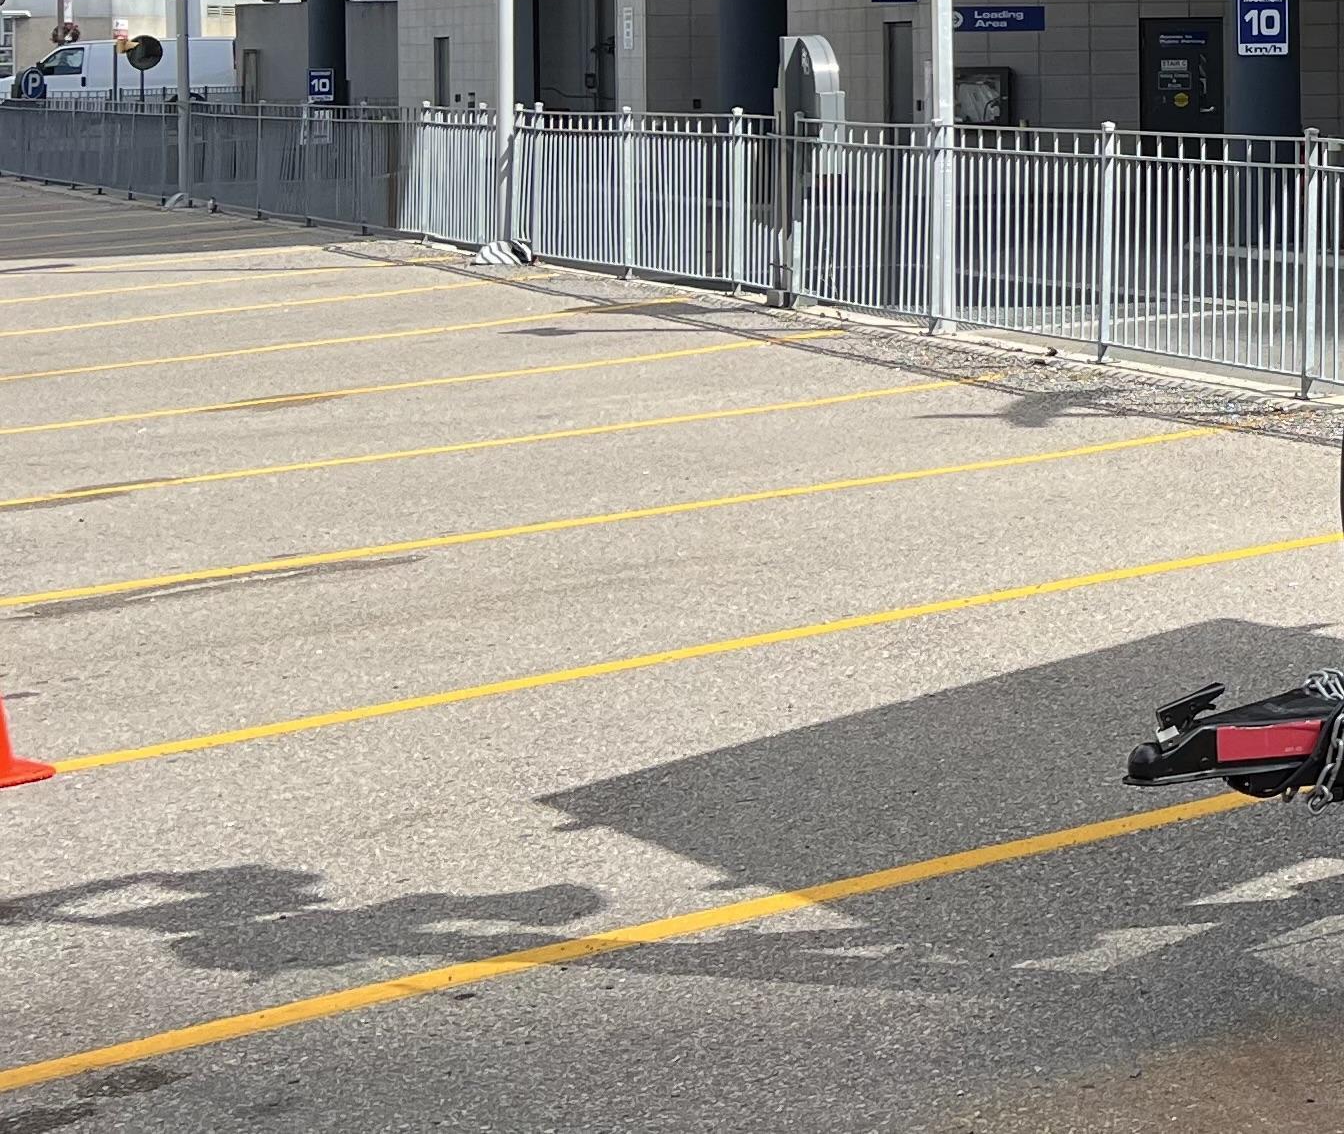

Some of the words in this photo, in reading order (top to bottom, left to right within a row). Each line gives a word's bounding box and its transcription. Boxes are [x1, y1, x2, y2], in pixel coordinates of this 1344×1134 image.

[974, 10, 1024, 20] Loading
[975, 19, 1007, 27] Area
[1244, 9, 1280, 36] 10
[1245, 45, 1283, 53] km/h
[27, 73, 40, 95] P
[311, 78, 330, 92] 10
